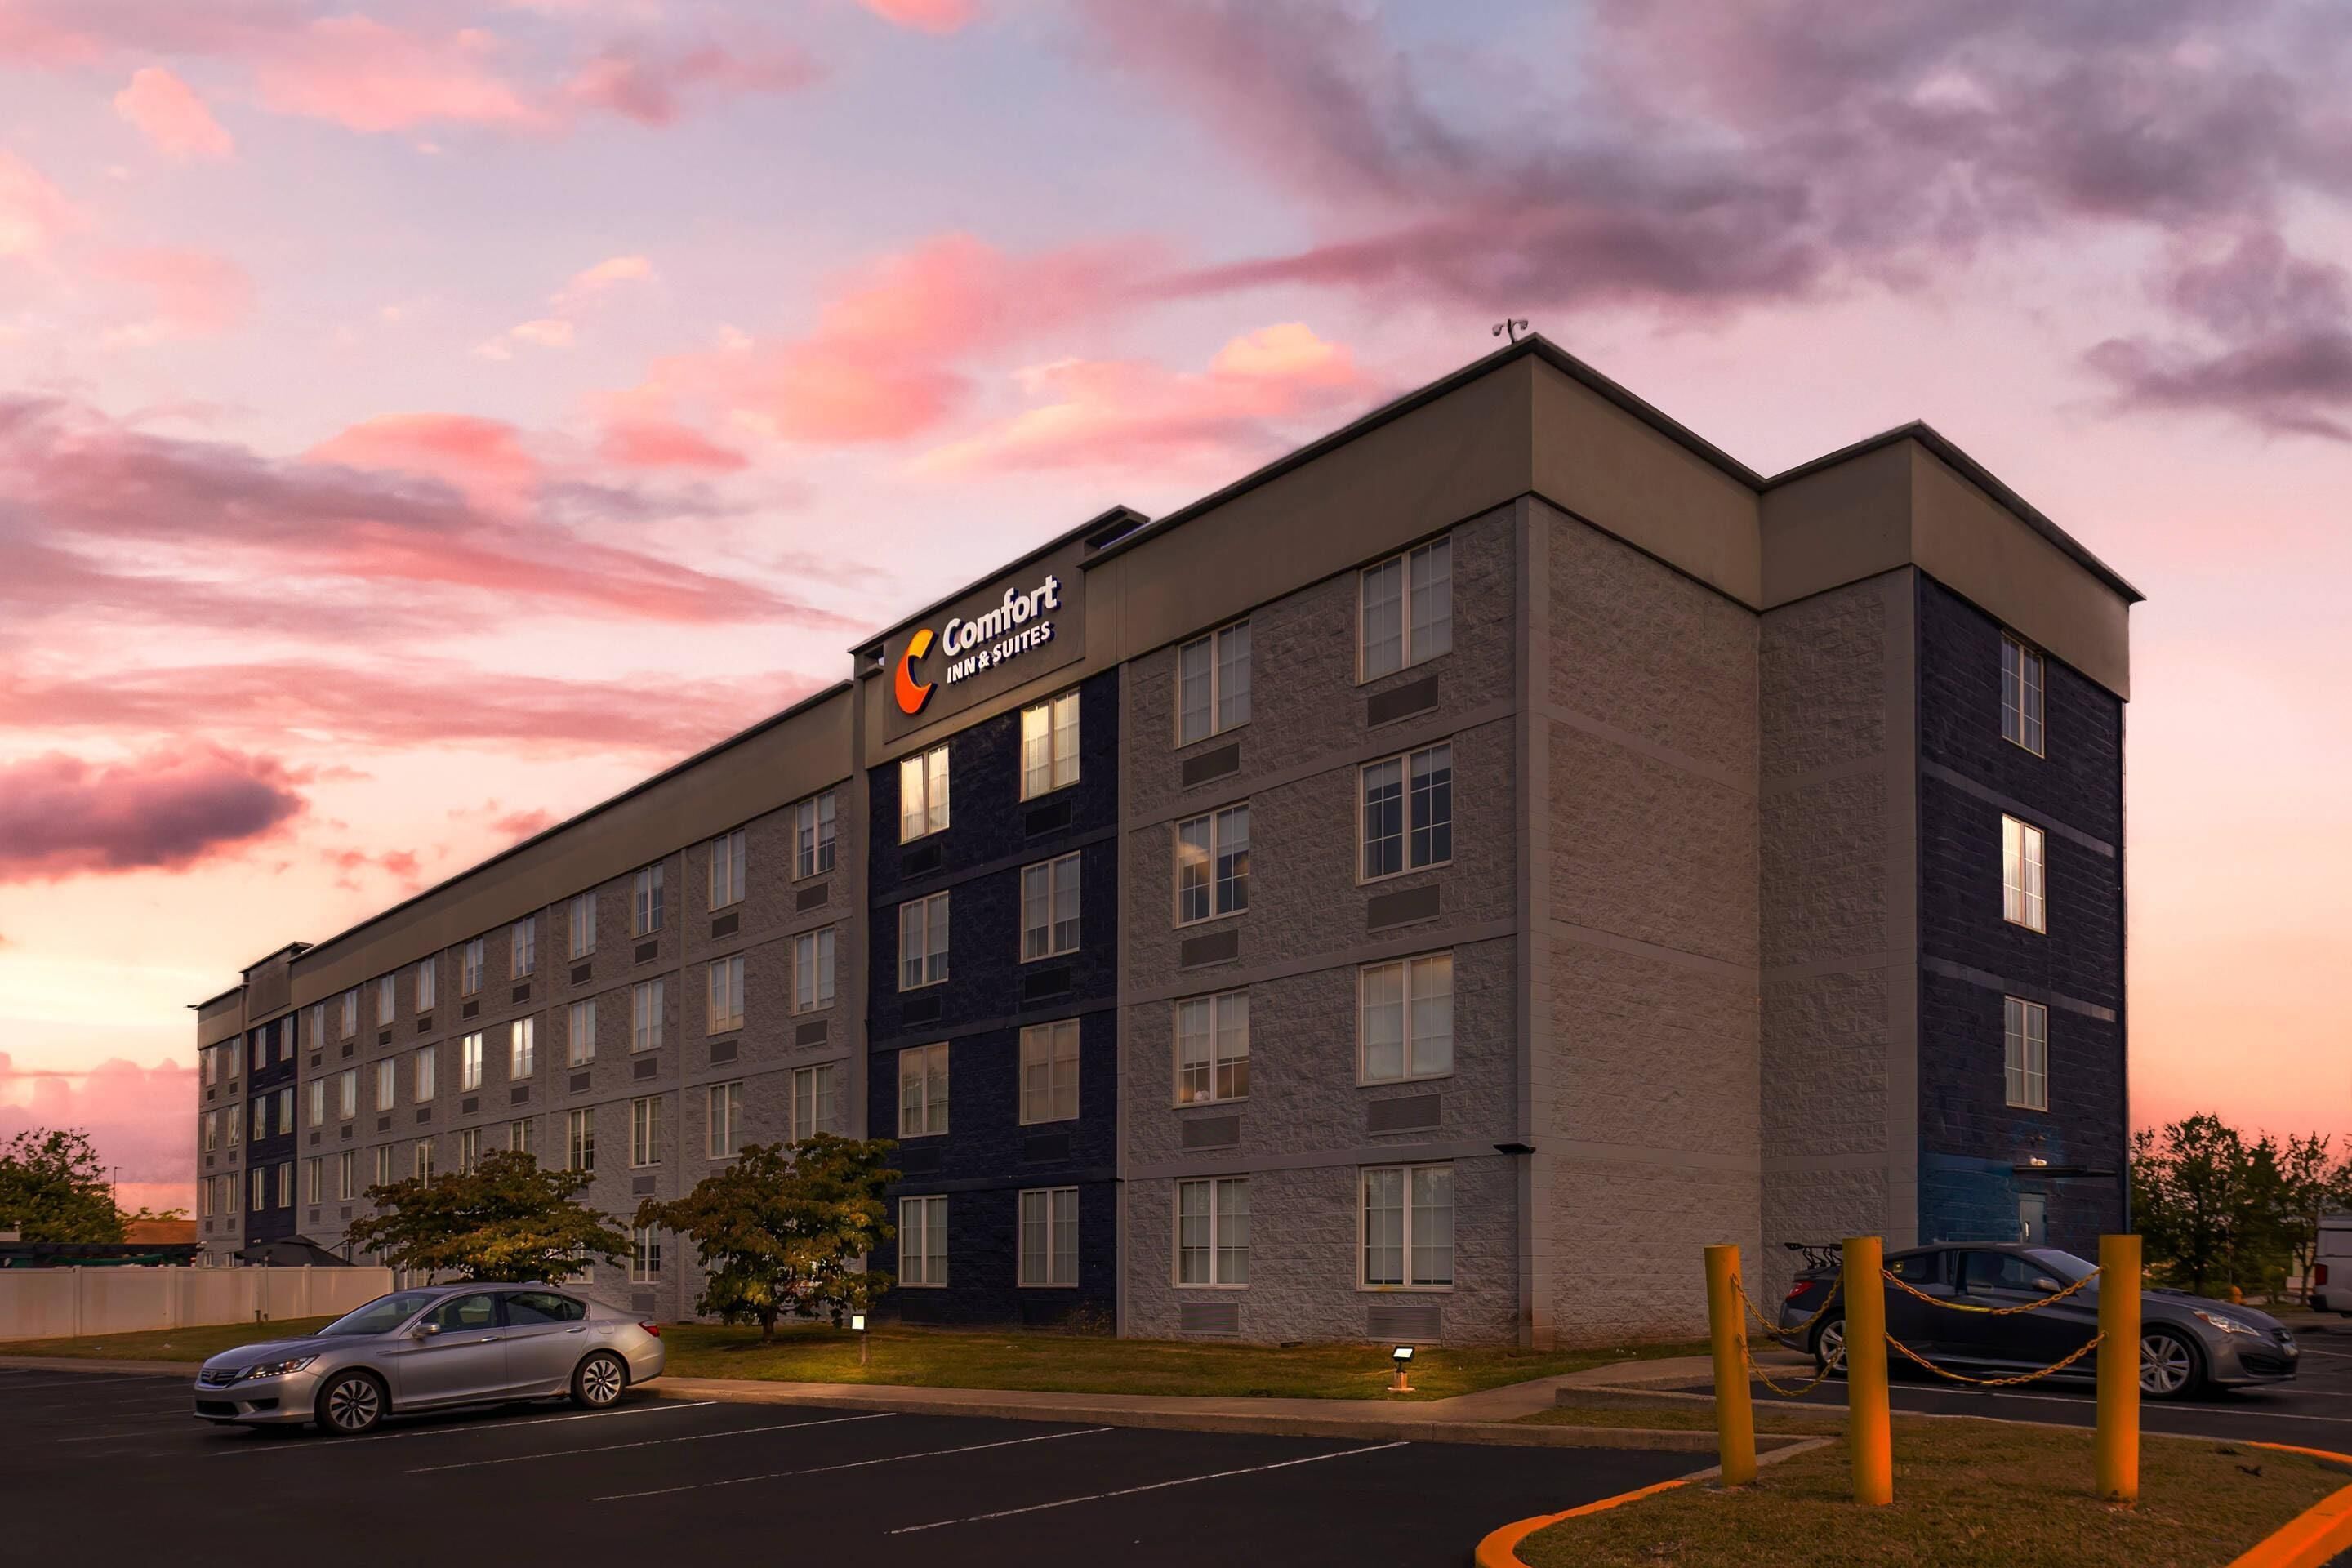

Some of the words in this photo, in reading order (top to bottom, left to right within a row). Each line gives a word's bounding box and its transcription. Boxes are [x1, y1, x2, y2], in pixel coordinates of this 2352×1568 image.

[942, 575, 1058, 657] Comfort
[947, 657, 976, 684] INN
[978, 650, 990, 669] &
[992, 621, 1051, 662] SUITES
